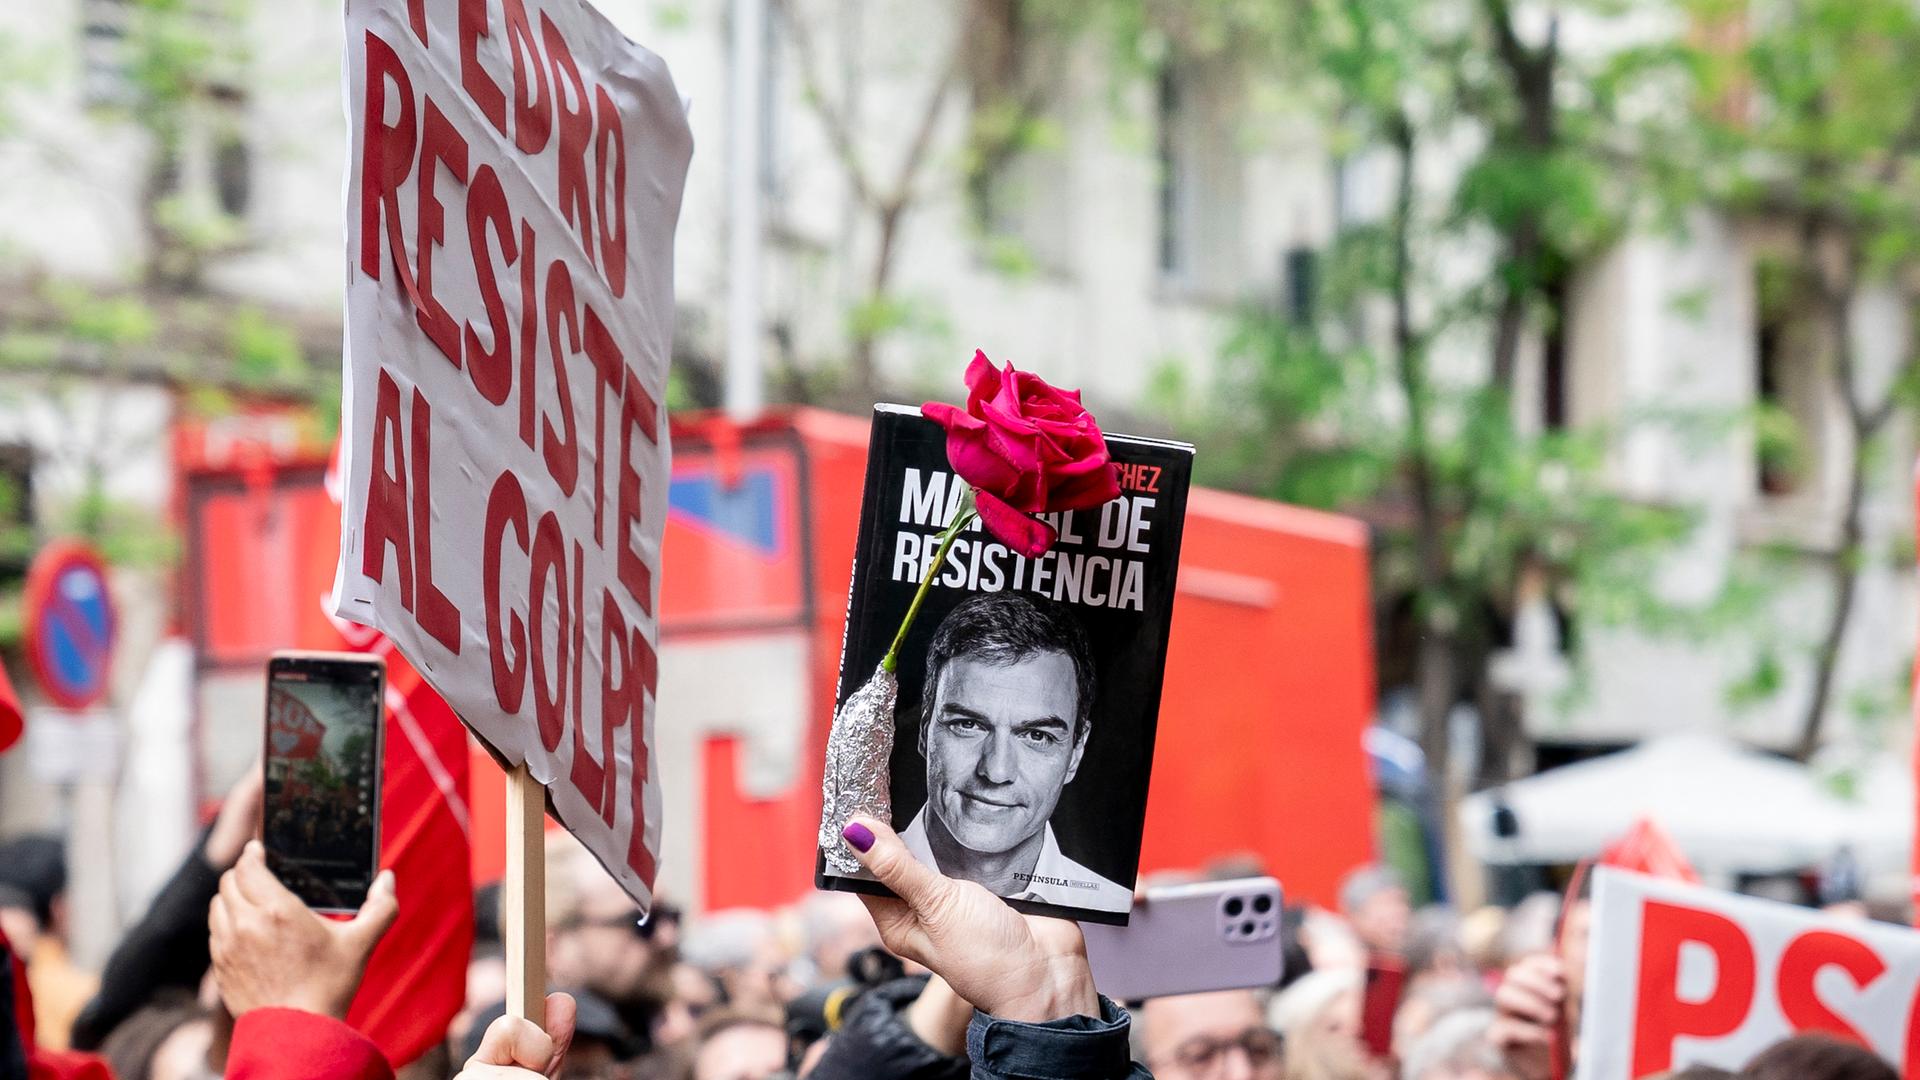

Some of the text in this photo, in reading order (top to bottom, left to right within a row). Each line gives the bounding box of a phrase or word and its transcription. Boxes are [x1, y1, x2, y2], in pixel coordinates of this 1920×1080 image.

[407, 0, 627, 300] EDRO
[360, 29, 658, 618] RESISTE
[892, 530, 1145, 612] RESISTENCIA
[1098, 495, 1156, 553] DE
[363, 367, 658, 894] AL GOLPE
[1013, 872, 1069, 887] PENÍNSULA
[1630, 897, 1920, 1080] PS
